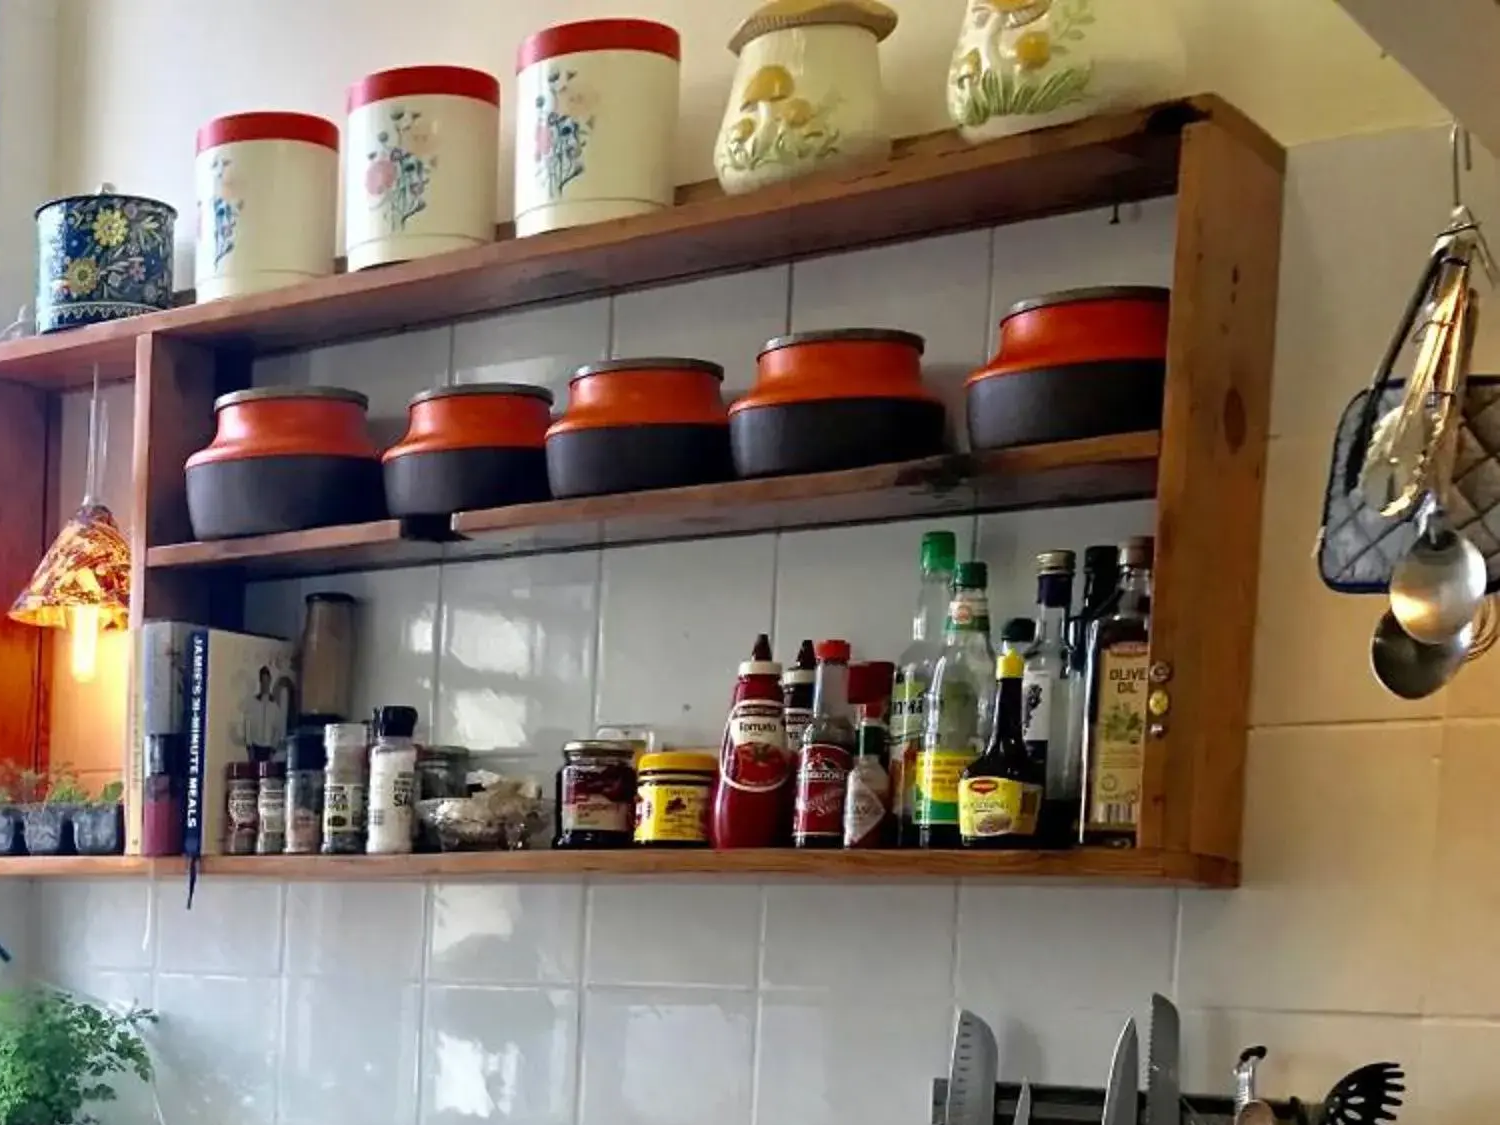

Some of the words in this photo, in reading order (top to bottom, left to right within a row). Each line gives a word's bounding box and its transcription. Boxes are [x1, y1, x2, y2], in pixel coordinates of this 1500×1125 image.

[1109, 668, 1148, 681] OLIVE
[1117, 681, 1138, 694] OIL
[187, 777, 199, 829] MEALS
